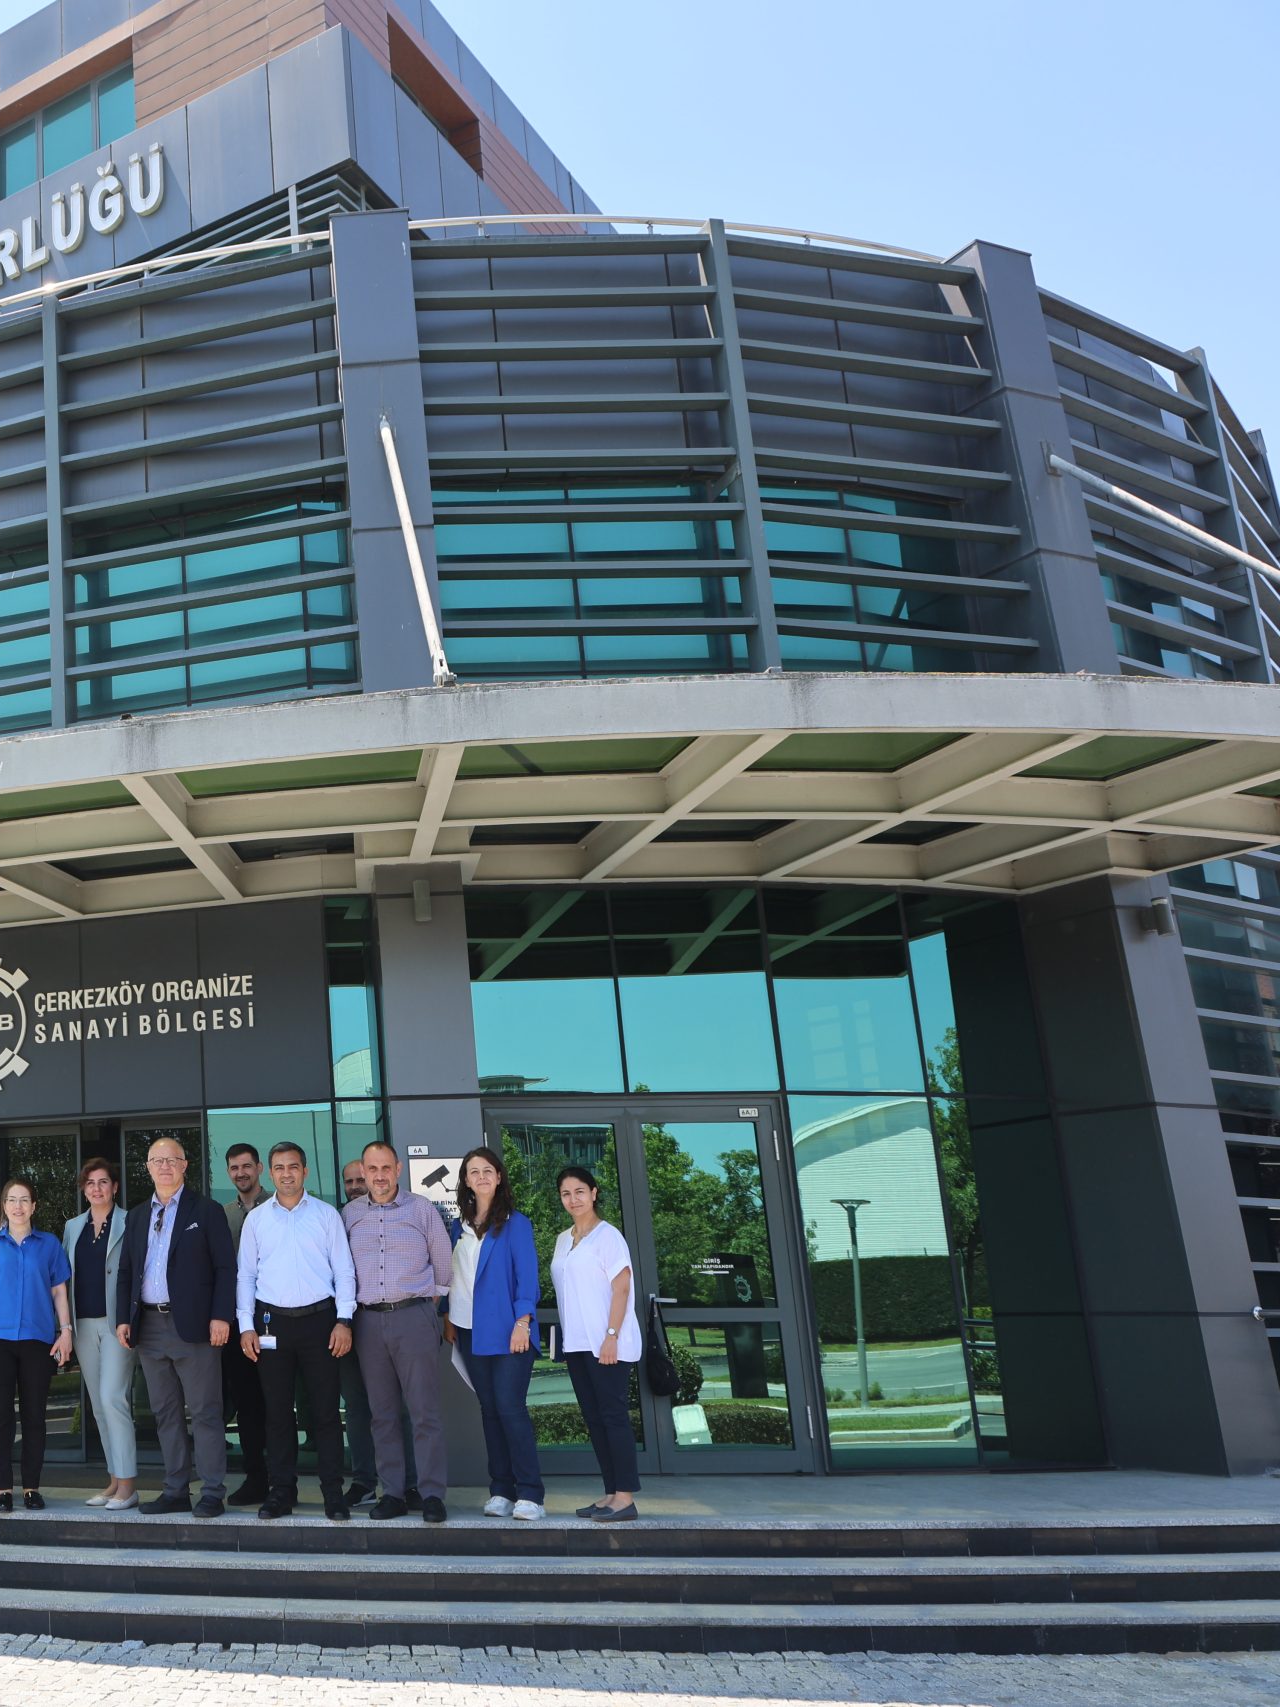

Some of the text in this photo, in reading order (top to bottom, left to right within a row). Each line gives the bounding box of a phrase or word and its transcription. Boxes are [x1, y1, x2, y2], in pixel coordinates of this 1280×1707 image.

[34, 973, 254, 1017] ÇERKEZKÖY ORGANİZE
[34, 1001, 255, 1044] SANAYİ BÖLGESİ
